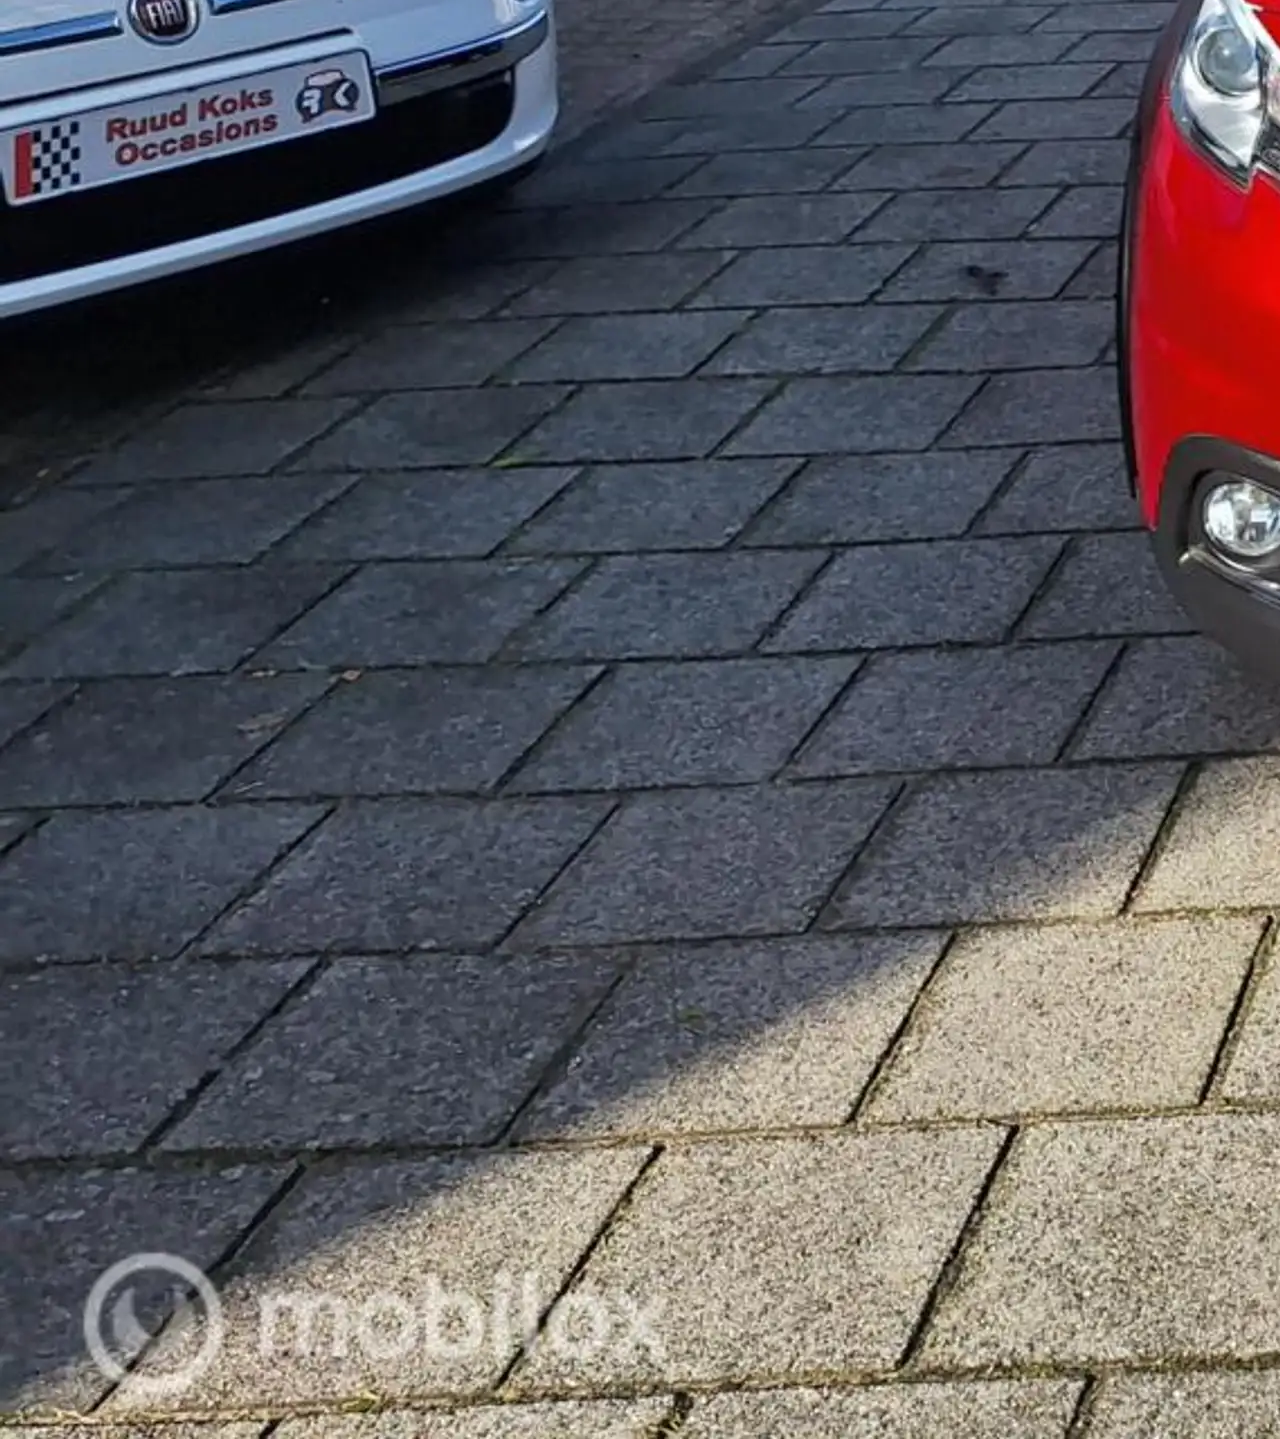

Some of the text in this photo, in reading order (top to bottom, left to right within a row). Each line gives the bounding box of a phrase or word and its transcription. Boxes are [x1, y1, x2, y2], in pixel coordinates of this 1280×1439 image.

[105, 88, 274, 143] Ruud Koks
[114, 112, 279, 166] Occasions
